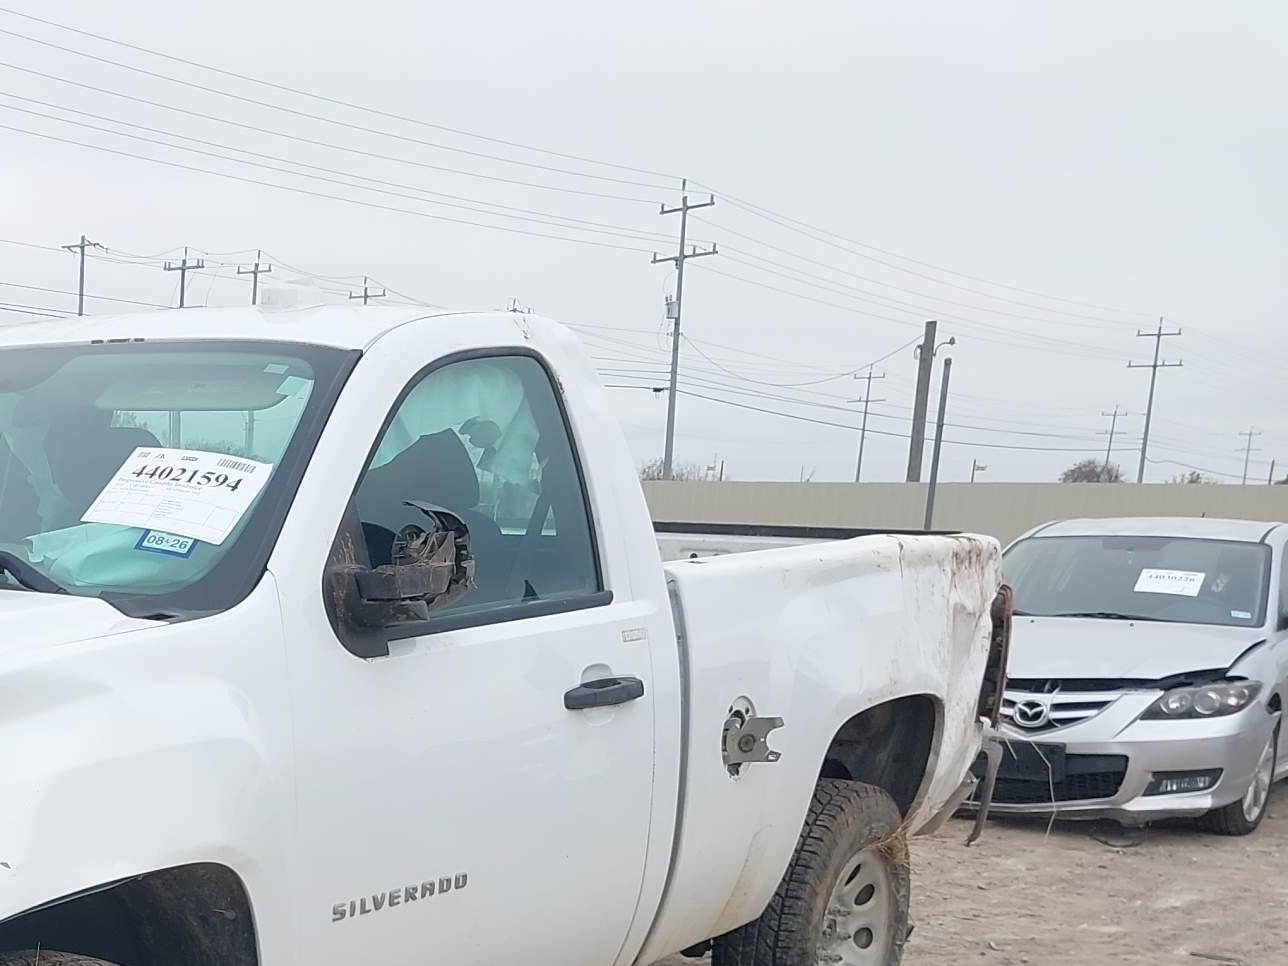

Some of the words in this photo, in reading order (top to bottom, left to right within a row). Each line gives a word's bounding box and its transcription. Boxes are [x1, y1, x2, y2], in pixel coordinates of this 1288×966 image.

[131, 465, 244, 492] 44021594
[146, 535, 165, 546] 08
[169, 539, 189, 550] 26
[331, 871, 468, 923] SILVERADO
